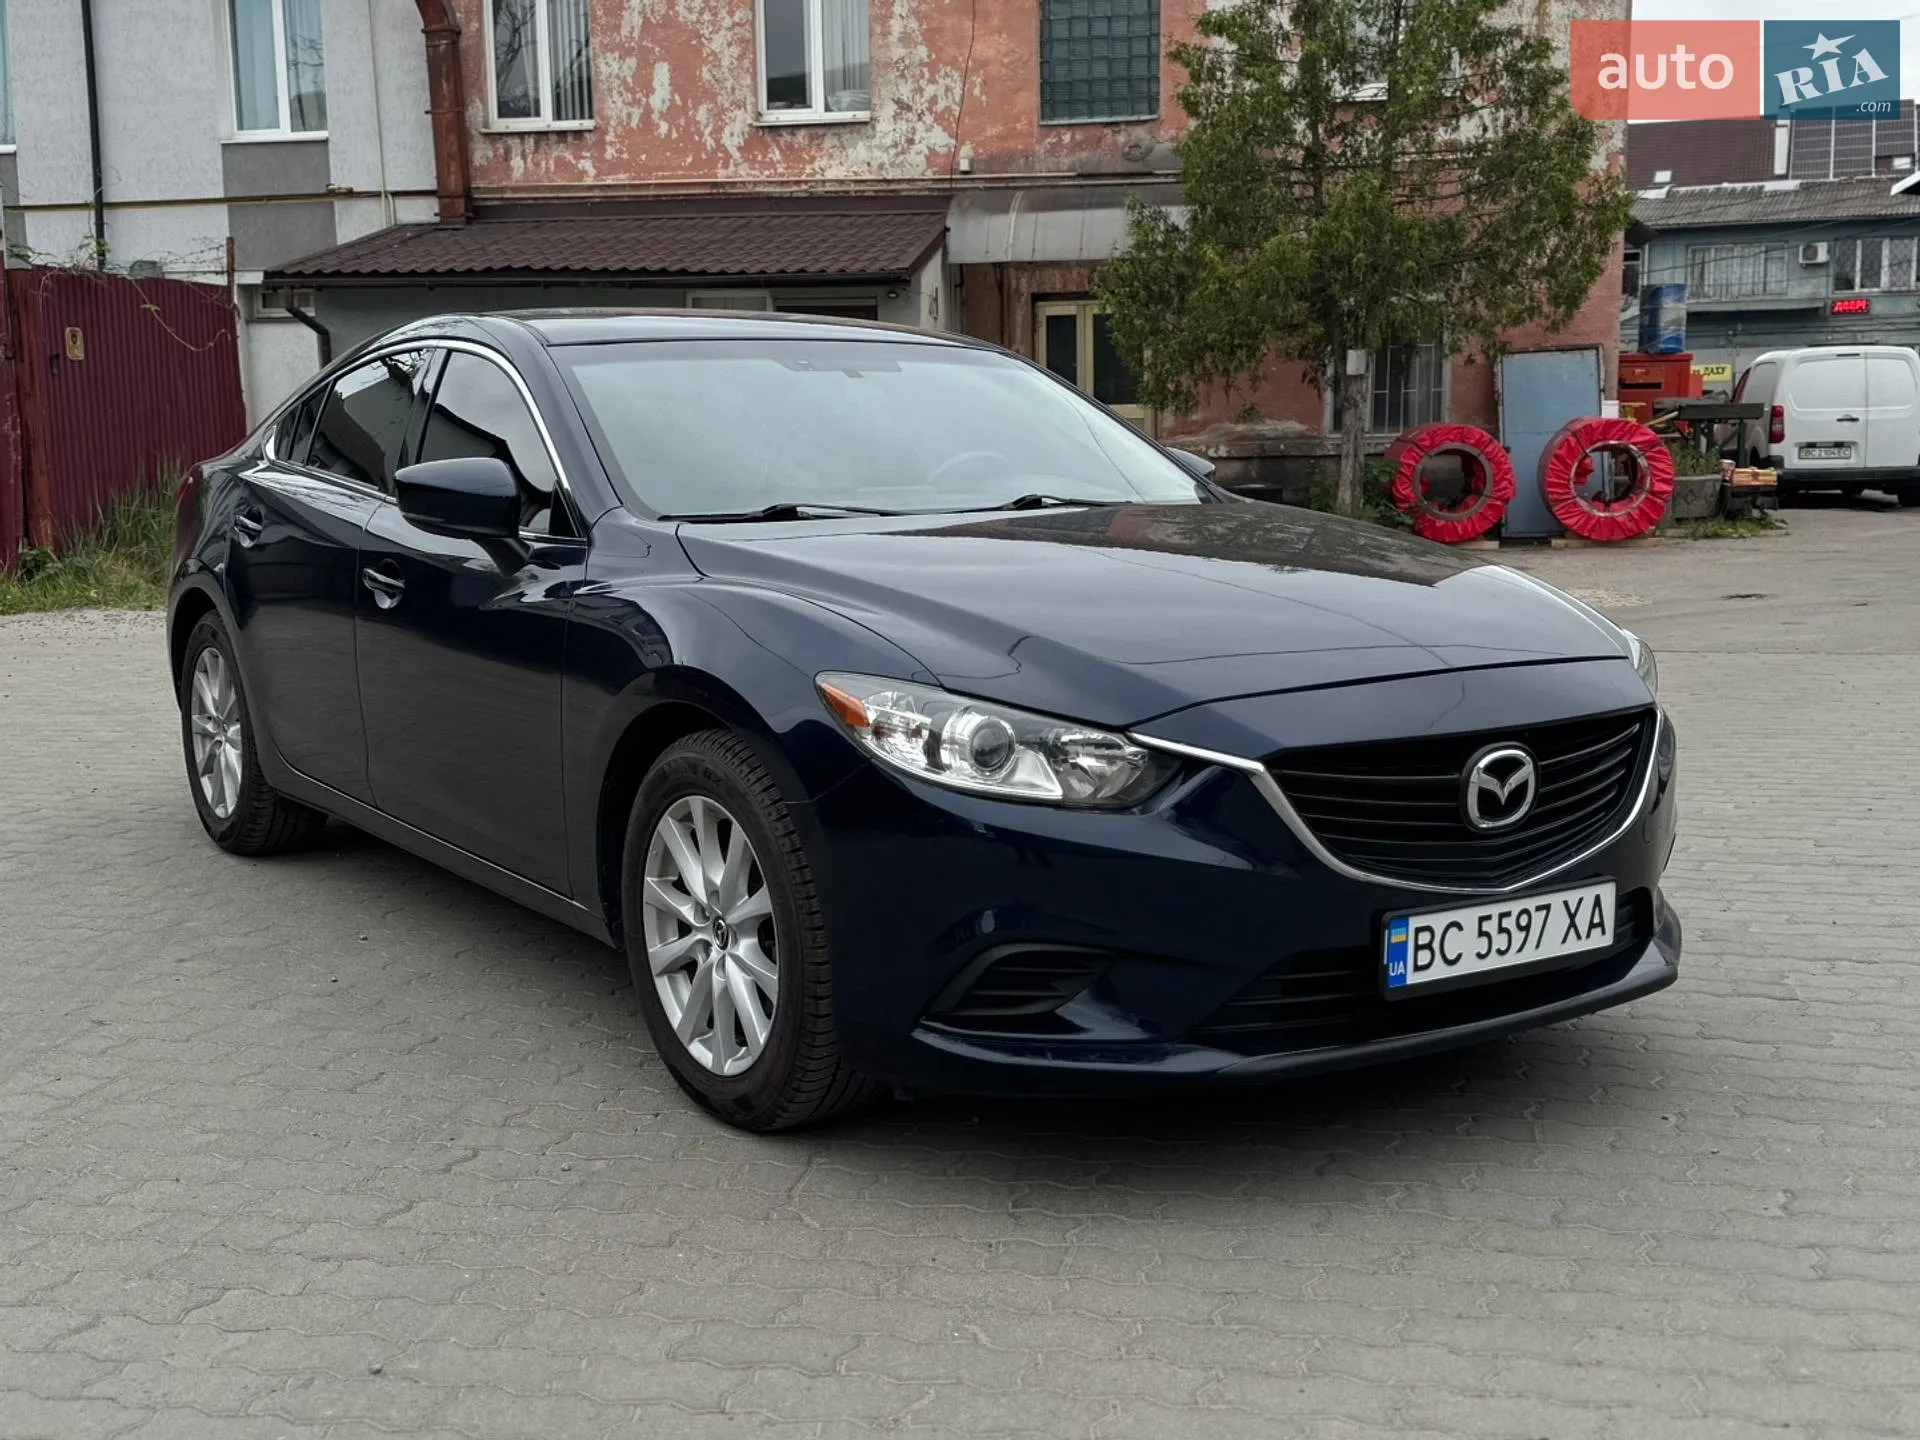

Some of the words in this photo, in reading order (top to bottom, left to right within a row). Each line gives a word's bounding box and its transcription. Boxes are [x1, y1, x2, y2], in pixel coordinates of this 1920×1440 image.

[1413, 920, 1464, 972] BC
[1475, 902, 1552, 960] 5597
[1560, 893, 1607, 944] XA
[1389, 960, 1406, 976] UA
